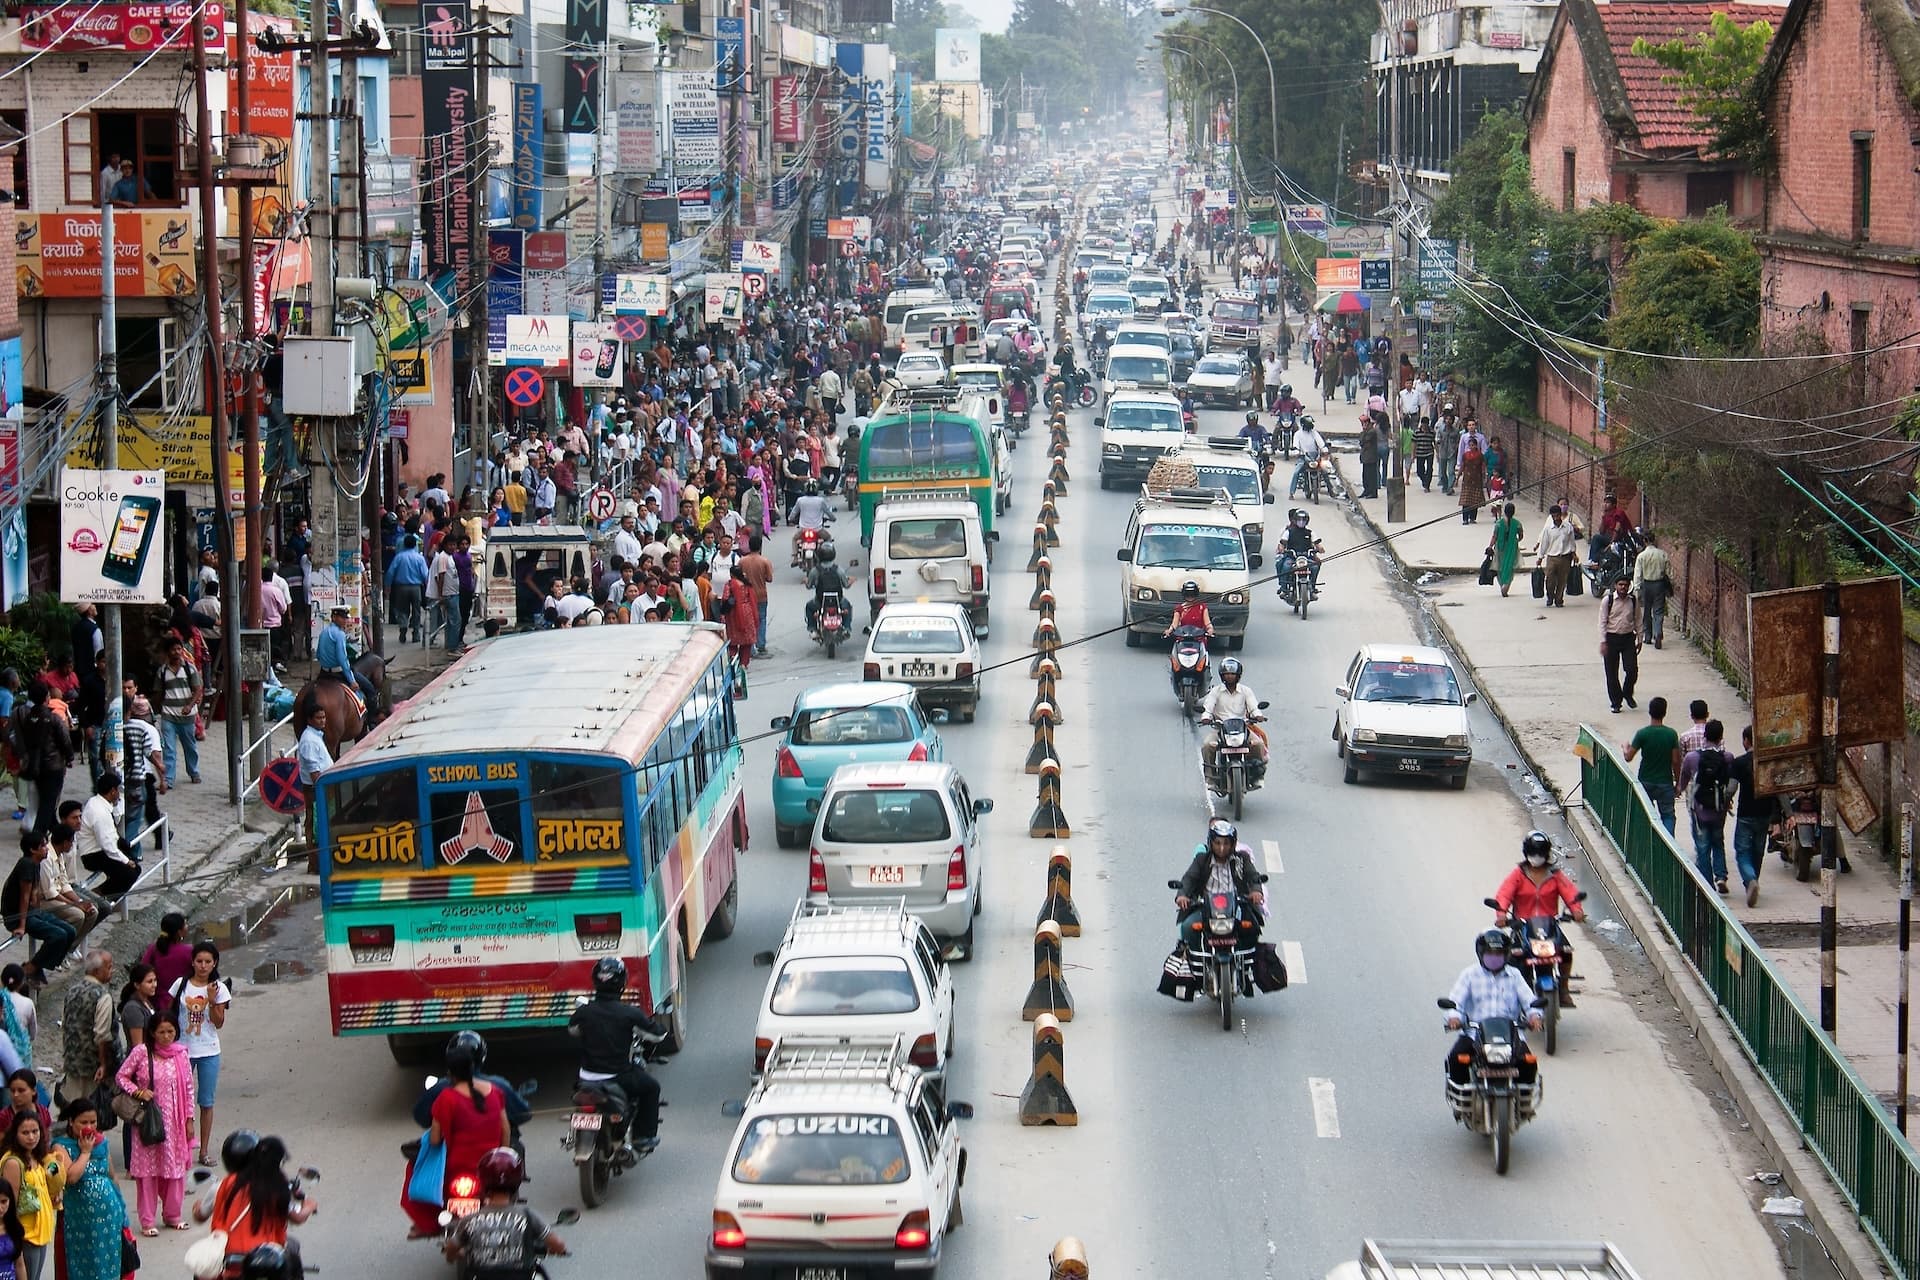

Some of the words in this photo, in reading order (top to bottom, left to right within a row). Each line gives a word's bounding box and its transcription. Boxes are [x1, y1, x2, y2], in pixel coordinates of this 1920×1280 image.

[61, 10, 80, 19] Enjoy!
[128, 6, 161, 17] CAFE
[428, 47, 465, 58] Maipal
[571, 0, 602, 126] MAYA
[779, 78, 793, 130] YAMAHA
[262, 107, 289, 118] GARDEN
[867, 79, 884, 160] PHILIPS
[446, 87, 469, 167] University
[517, 87, 535, 211] PENTASOFT
[432, 168, 444, 210] Learning
[449, 177, 472, 243] Manipal
[1289, 207, 1322, 218] FedEx
[433, 212, 445, 264] Authorised
[846, 243, 855, 254] P
[63, 267, 103, 277] SUMMER
[1337, 267, 1358, 280] HIEC
[750, 278, 761, 293] P
[619, 296, 642, 304] MEGA
[509, 343, 538, 352] MEGA
[540, 344, 563, 352] BANK
[161, 456, 197, 465] Thesis
[1196, 466, 1239, 475] TOYOTA
[144, 476, 157, 484] LG
[65, 486, 118, 502] Cookie
[598, 495, 611, 516] P
[78, 593, 115, 601] WONDERFUL
[428, 766, 480, 783] SCHOOL
[486, 762, 518, 779] BUS
[334, 820, 416, 864] ज्योति
[537, 819, 623, 861] ट्राभल्स
[357, 951, 391, 962] 5784
[777, 1116, 889, 1136] SUZUKI
